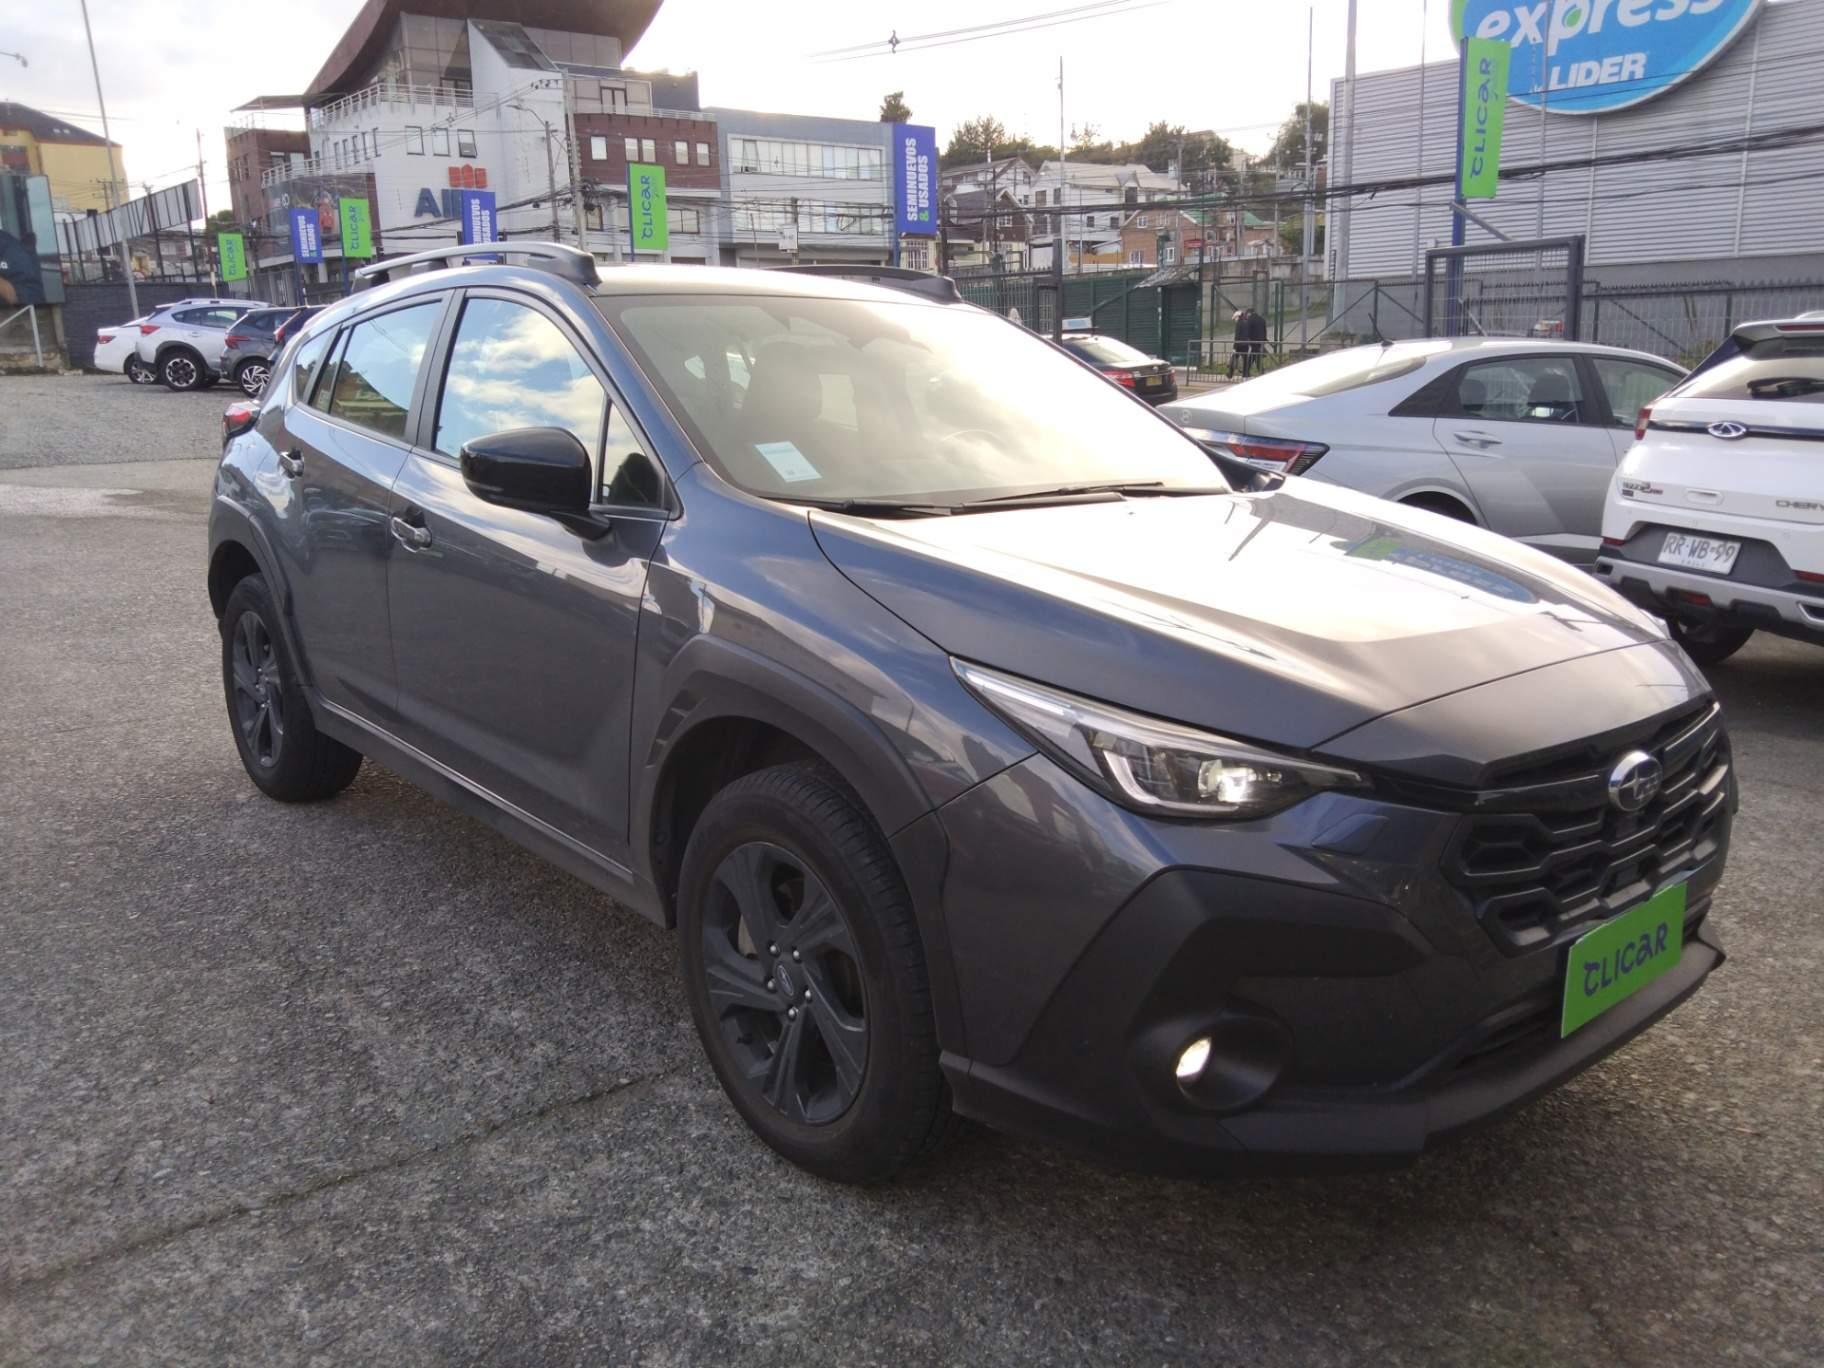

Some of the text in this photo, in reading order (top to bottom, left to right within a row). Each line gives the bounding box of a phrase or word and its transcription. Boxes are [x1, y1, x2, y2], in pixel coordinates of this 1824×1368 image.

[1549, 53, 1648, 90] LIDER
[905, 137, 918, 221] SEMINUEVOS
[917, 155, 929, 221] & USADOS
